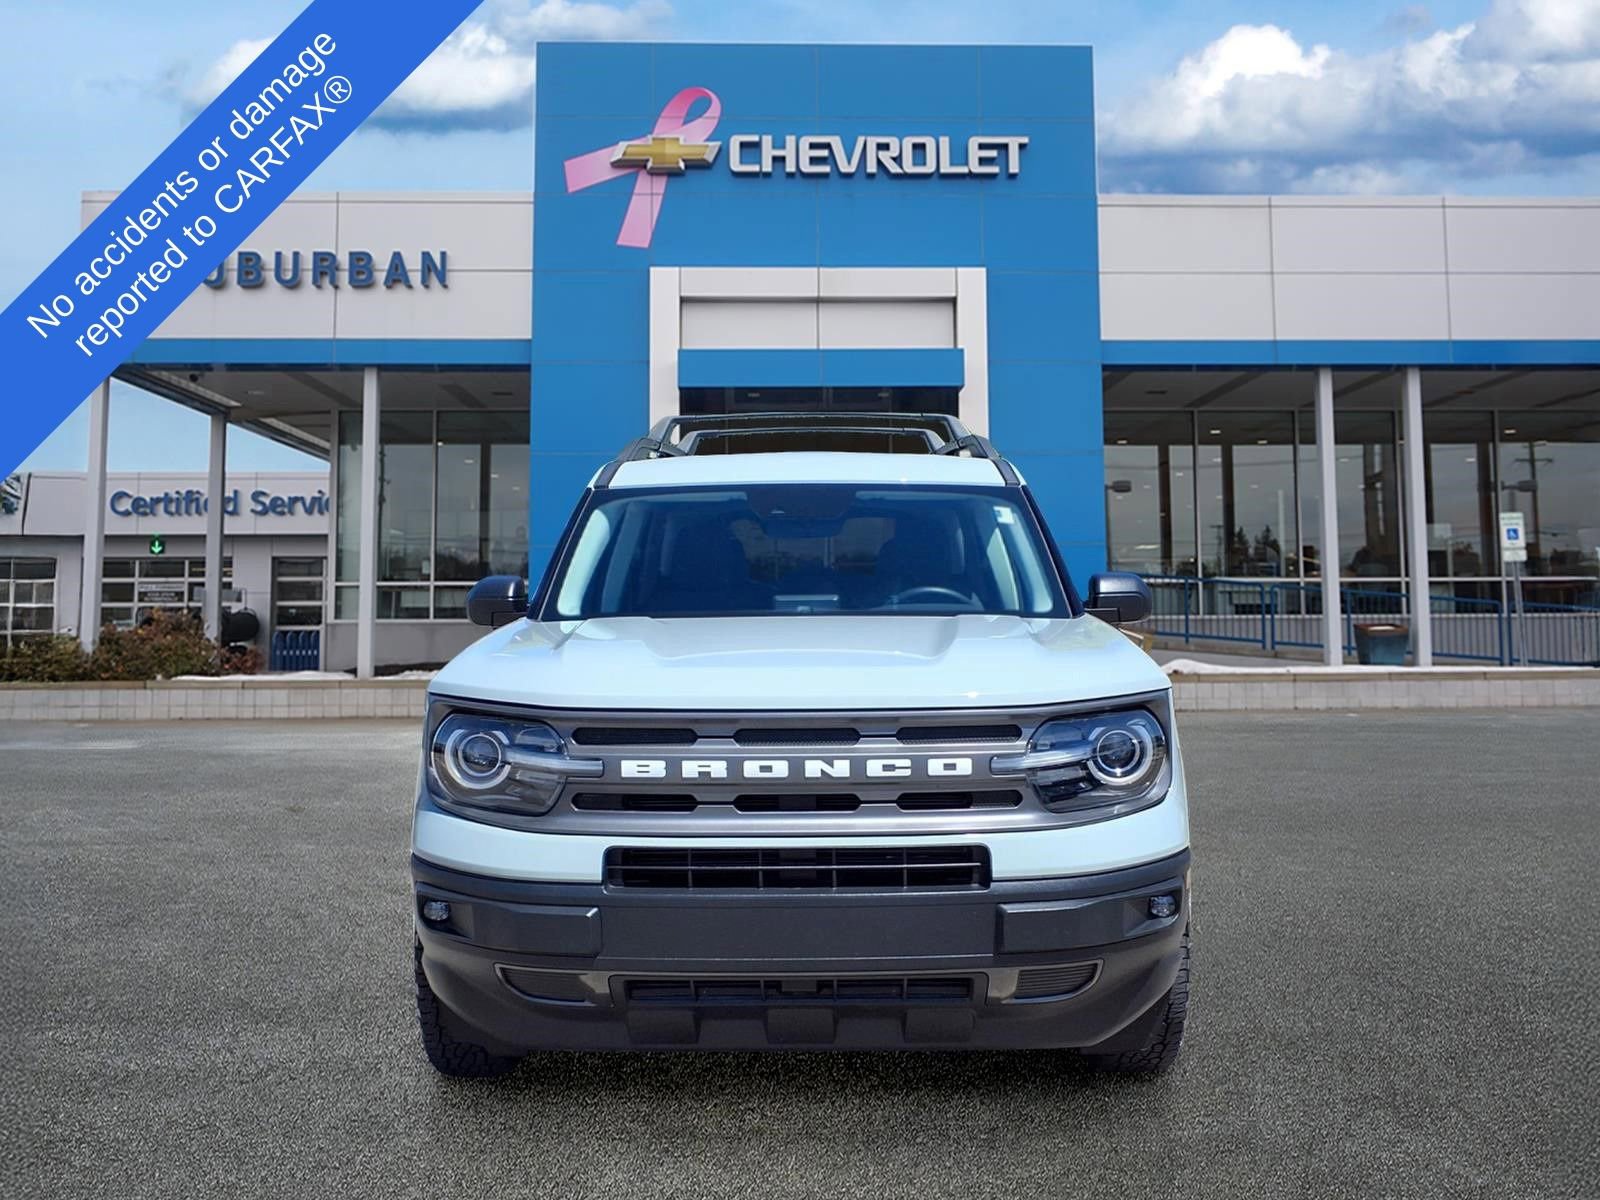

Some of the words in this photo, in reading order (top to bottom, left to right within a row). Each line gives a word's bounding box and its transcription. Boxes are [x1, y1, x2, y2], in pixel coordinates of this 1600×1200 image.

[728, 134, 1029, 177] CHEVROLET
[203, 251, 448, 289] UBURBAN
[110, 490, 240, 517] Certifid
[250, 490, 329, 516] Servi
[620, 758, 973, 778] BRONCO
